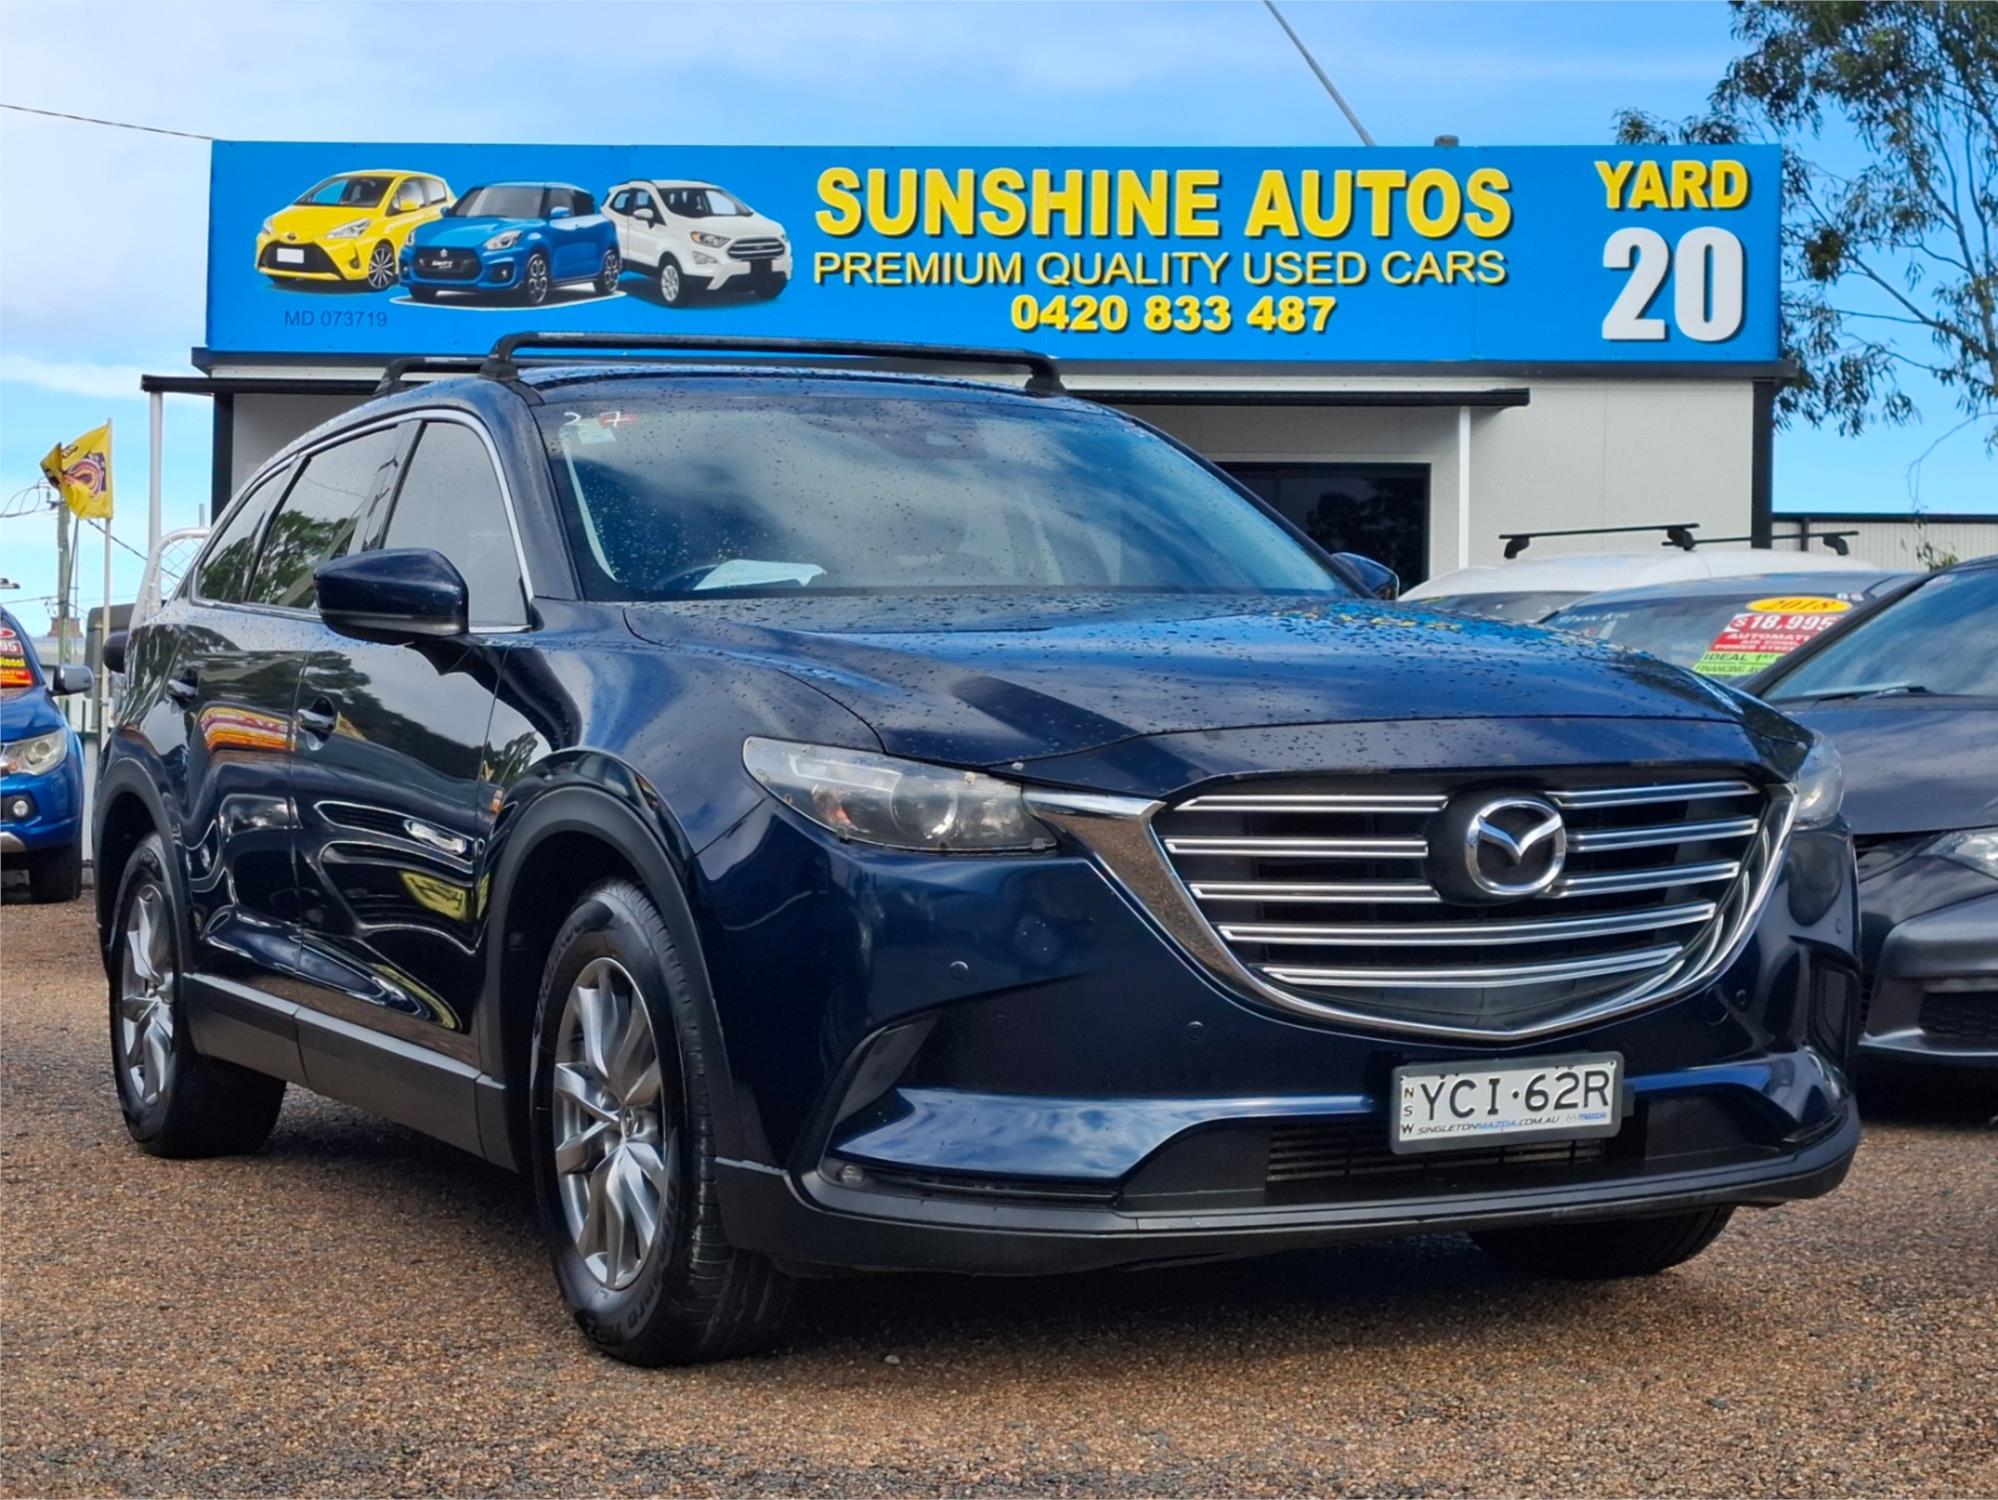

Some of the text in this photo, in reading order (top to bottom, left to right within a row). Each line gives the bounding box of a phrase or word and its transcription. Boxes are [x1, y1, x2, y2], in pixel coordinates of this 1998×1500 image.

[814, 167, 1511, 239] SUNSHINE AUTOS
[1594, 160, 1749, 210] YARD
[813, 251, 1506, 288] PREMIUM QUALITY USED CARS
[1602, 226, 1744, 342] 20
[284, 310, 388, 328] MD 073719
[1011, 295, 1336, 333] 0420 833 487
[1764, 599, 1837, 610] 2018
[1726, 632, 1812, 641] AUTOMATI
[1703, 653, 1749, 662] IDEAL
